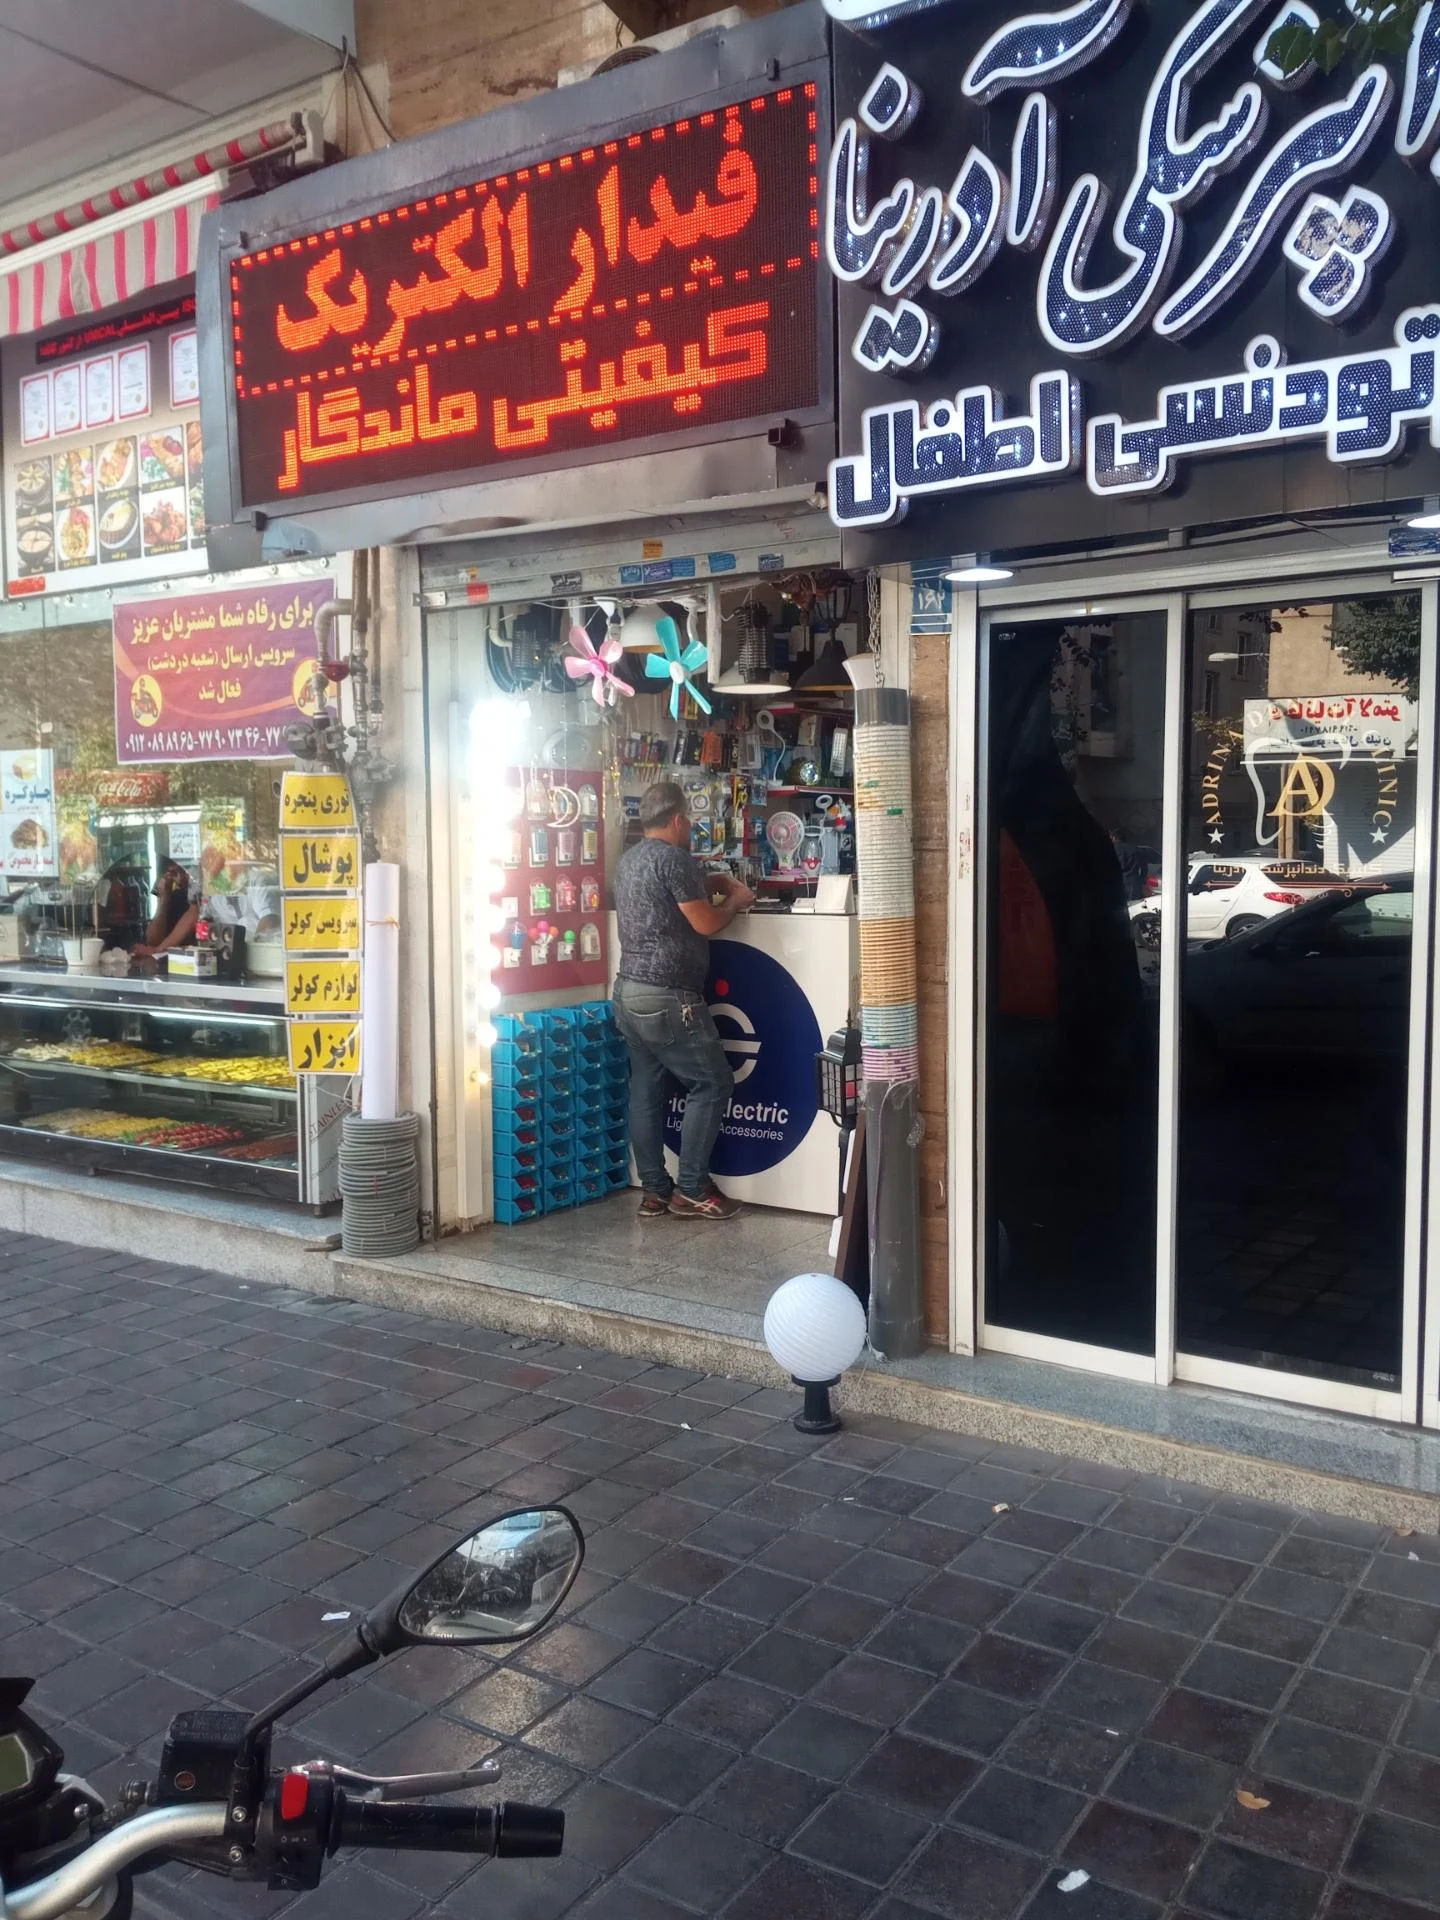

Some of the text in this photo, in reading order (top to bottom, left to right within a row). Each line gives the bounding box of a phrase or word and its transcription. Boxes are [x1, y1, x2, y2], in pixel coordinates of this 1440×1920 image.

[276, 117, 758, 358] فیدار الکتریک
[277, 301, 769, 490] کیفیتی ماندگار
[827, 369, 1070, 527] اطفال
[130, 595, 314, 644] برای رفاه شما مشتریان عزیز
[222, 644, 253, 670] ارسال
[254, 648, 296, 667] سرویس
[198, 677, 242, 704] فعال شد
[1202, 730, 1244, 825] ADRINA
[284, 788, 350, 815] توری پنجره
[293, 841, 354, 885] پوشال
[287, 911, 357, 935] سرویس کولر
[290, 974, 358, 1002] لوازم کولر
[298, 1027, 356, 1069] ابزار
[723, 1097, 789, 1125] lectric
[719, 1122, 784, 1141] Accessories
